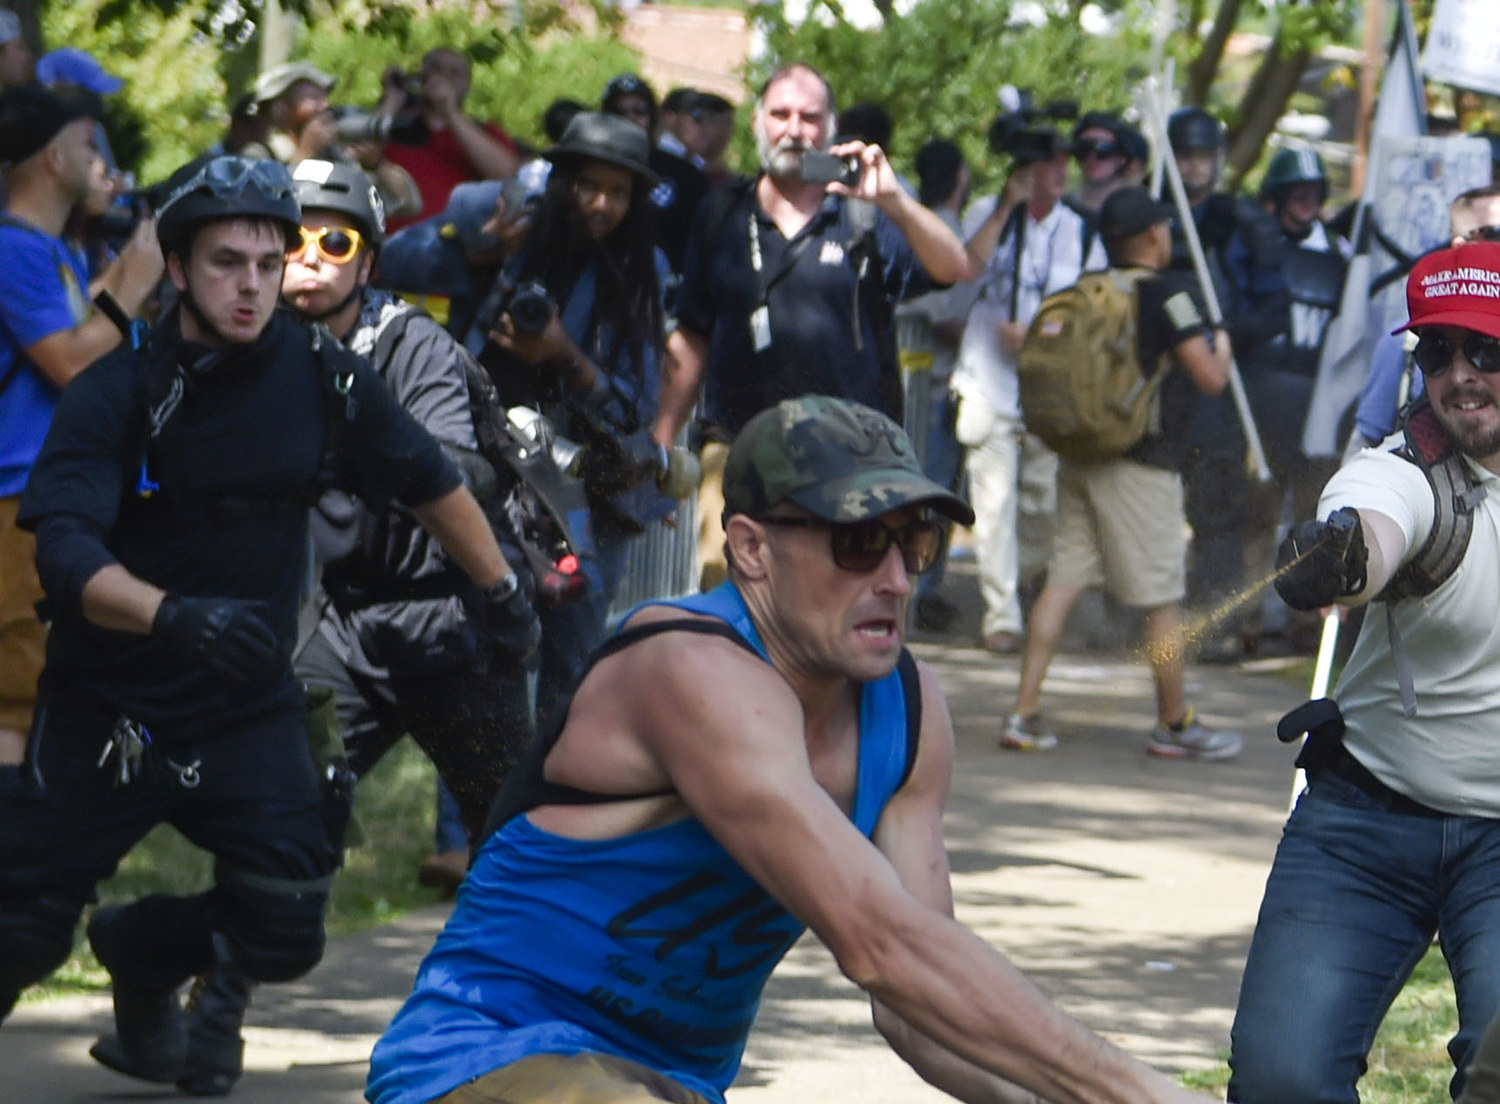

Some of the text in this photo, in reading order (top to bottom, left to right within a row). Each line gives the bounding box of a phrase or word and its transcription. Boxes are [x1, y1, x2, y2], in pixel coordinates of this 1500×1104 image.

[1421, 270, 1452, 286] MAKE
[1424, 282, 1500, 298] GREAT AGAIN
